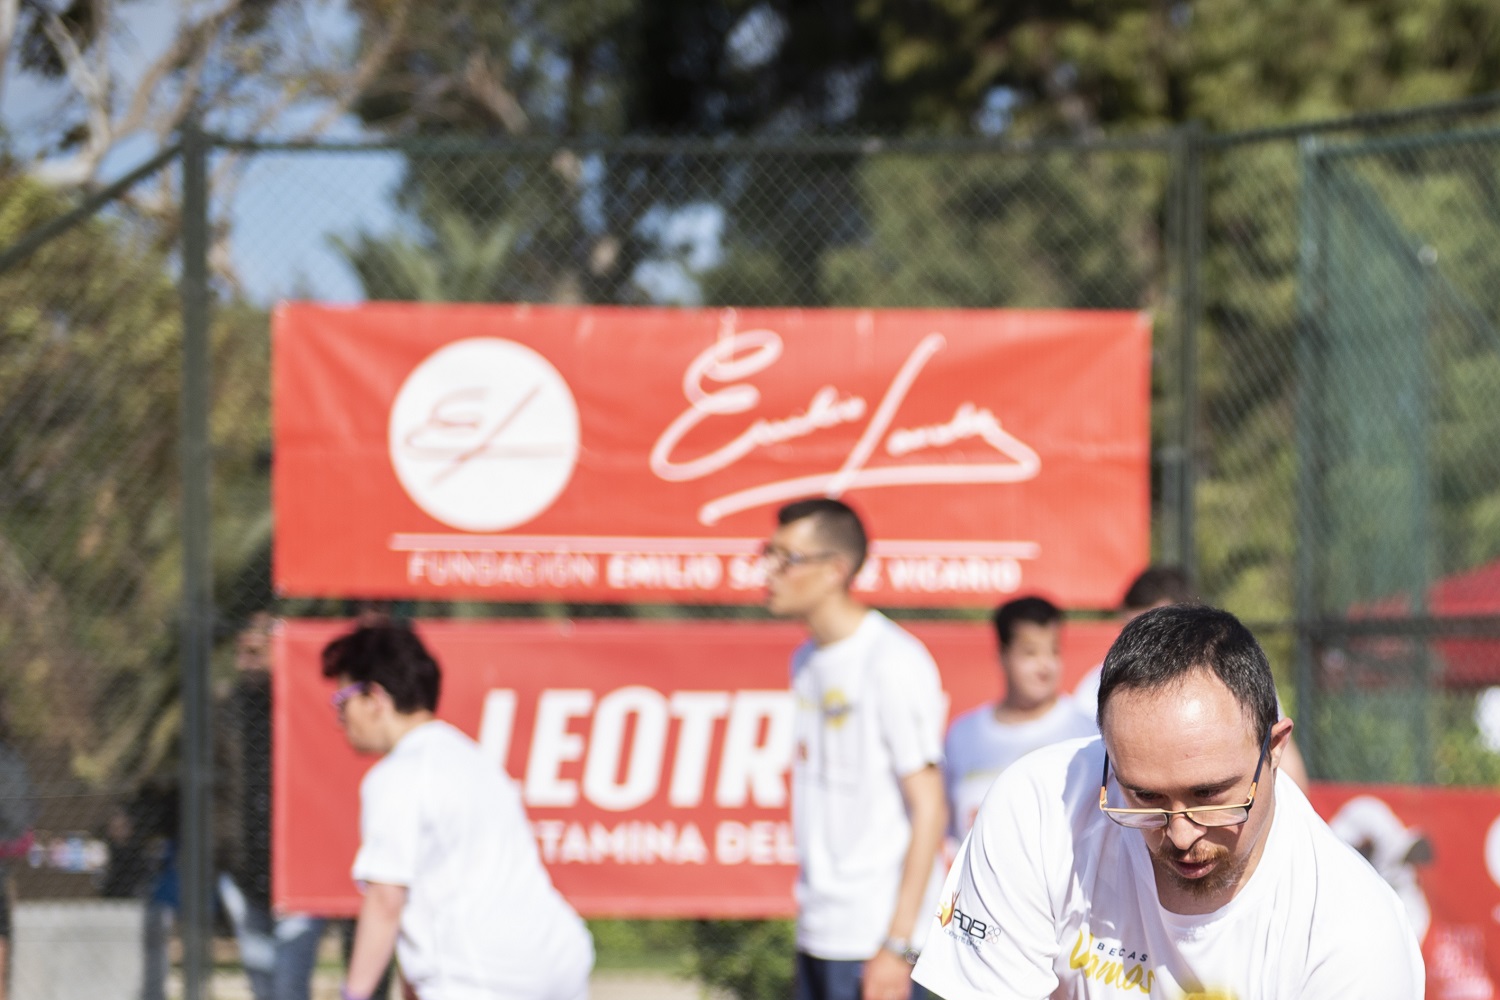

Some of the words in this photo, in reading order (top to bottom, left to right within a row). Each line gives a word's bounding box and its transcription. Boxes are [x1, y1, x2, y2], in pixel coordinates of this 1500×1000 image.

[407, 546, 598, 588] FUNDACIÓN
[605, 552, 722, 590] EMILIO
[478, 685, 796, 812] LEOTR
[533, 819, 707, 864] TAMINA
[1070, 928, 1155, 993] Vamos
[1097, 942, 1148, 962] BECAS
